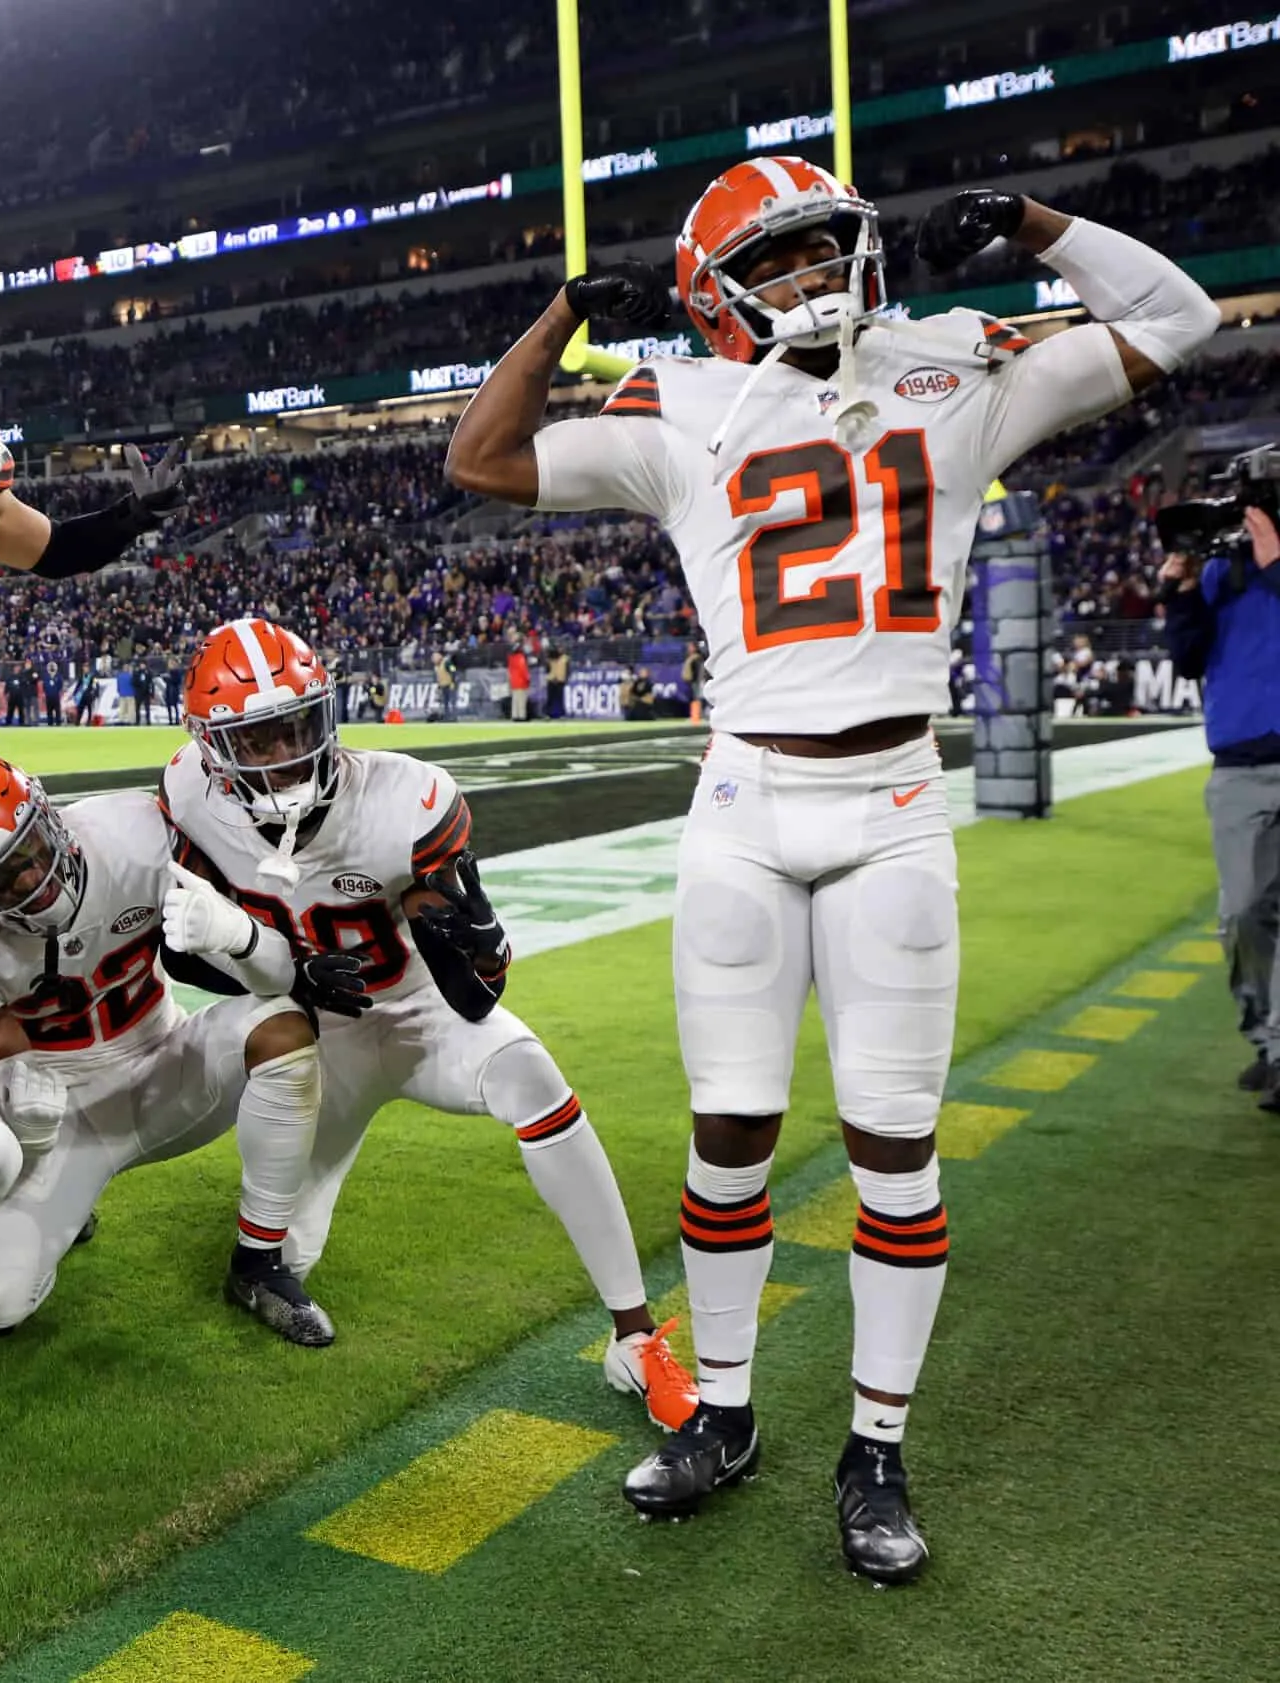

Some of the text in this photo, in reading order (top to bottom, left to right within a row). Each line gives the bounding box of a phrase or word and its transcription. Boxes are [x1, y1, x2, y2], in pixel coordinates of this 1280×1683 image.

[8, 268, 48, 288] 12:54
[248, 224, 278, 243] QTR
[343, 208, 356, 224] 9
[417, 192, 437, 211] 47
[904, 373, 949, 396] 1946
[726, 427, 940, 653] 21
[389, 682, 471, 709] RAVES
[339, 878, 373, 894] 1946
[118, 908, 148, 931] 1946
[7, 925, 165, 1051] 22
